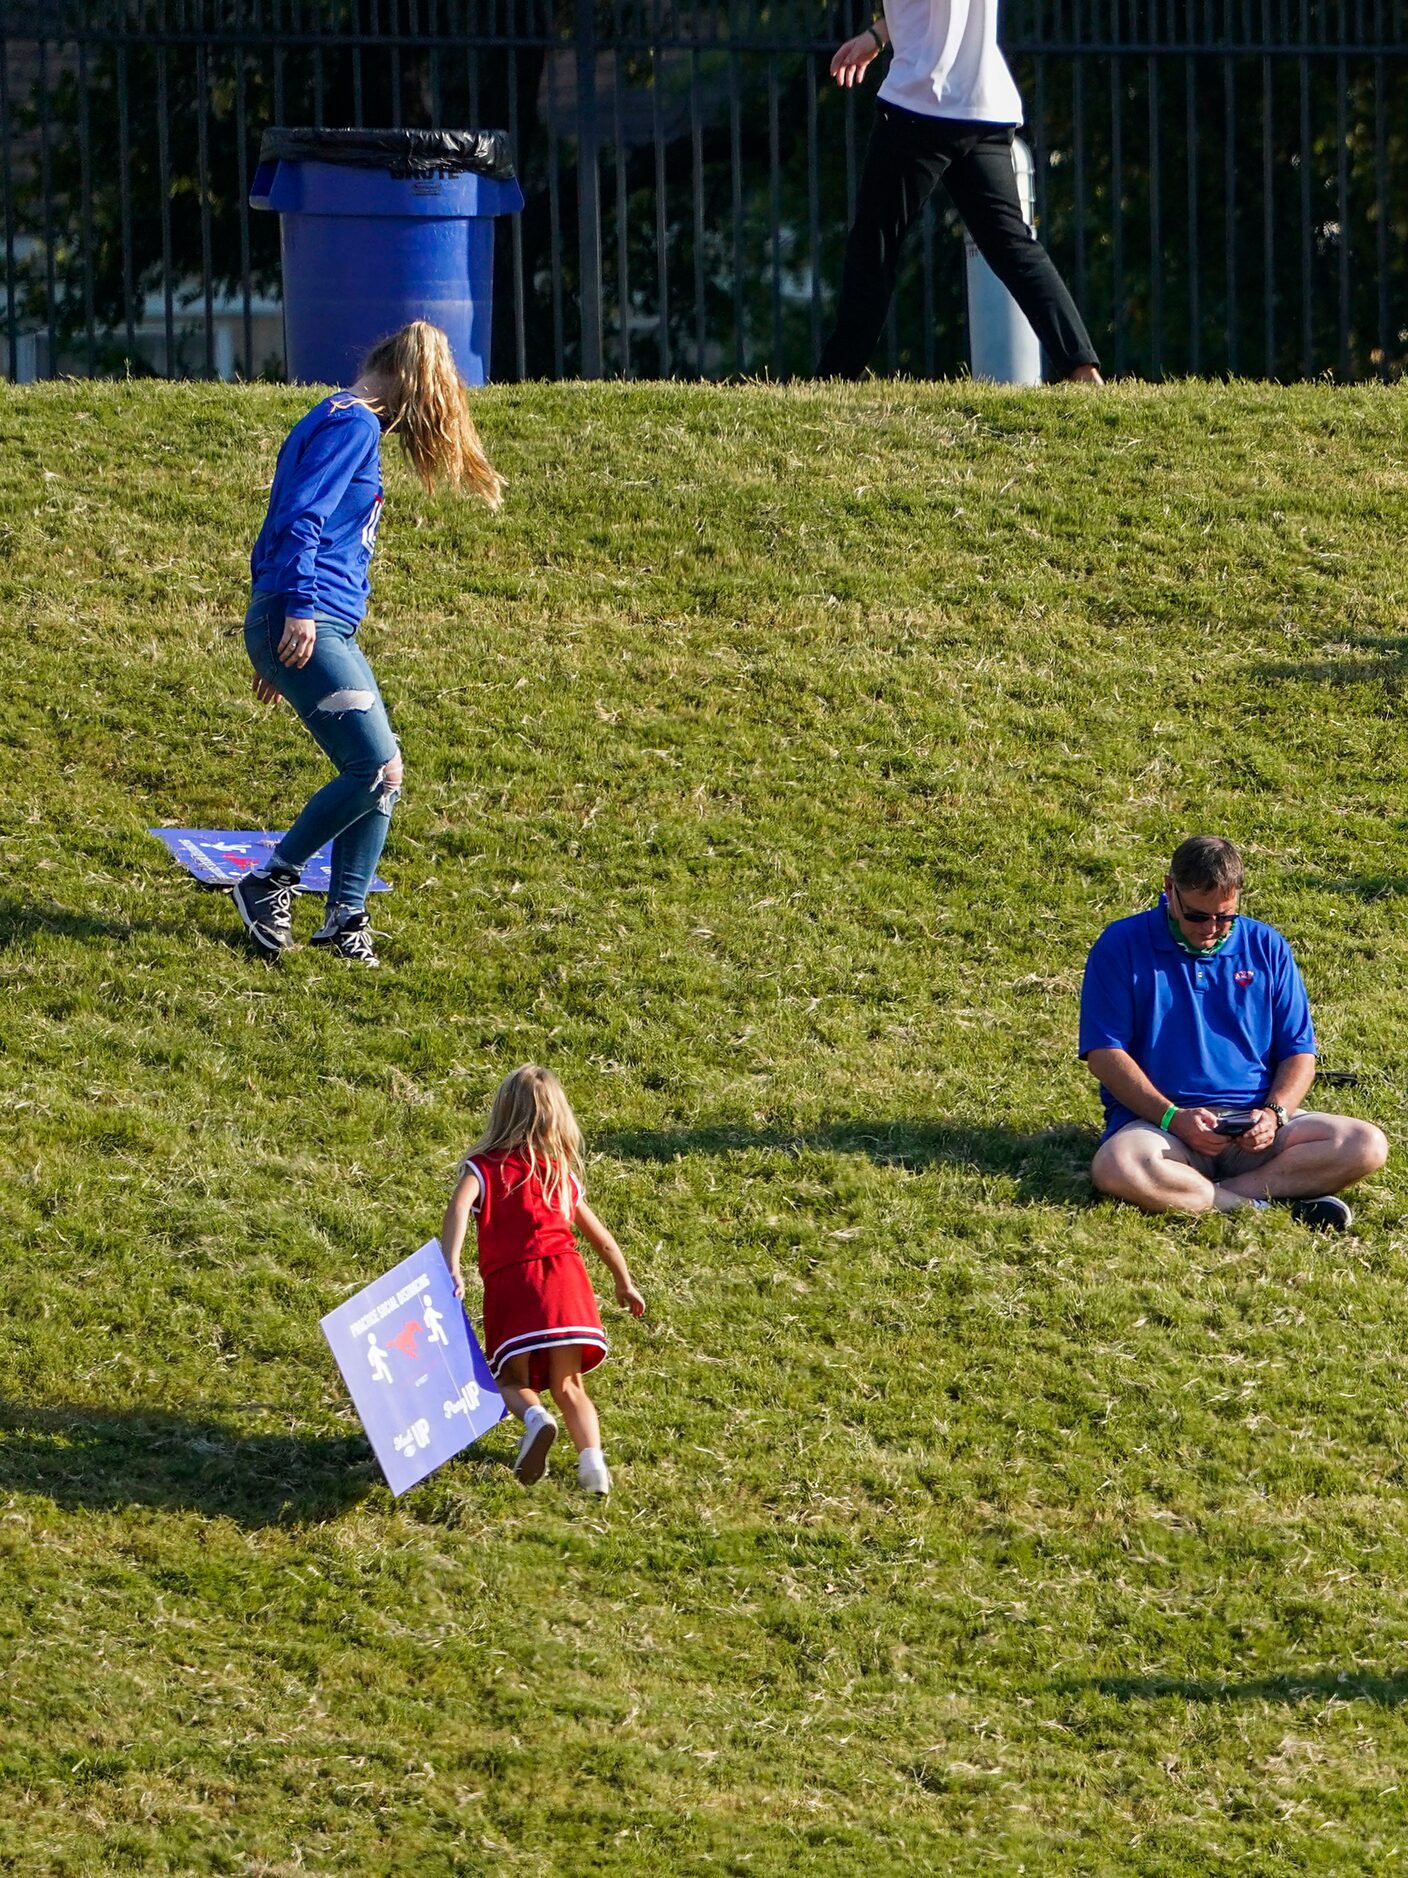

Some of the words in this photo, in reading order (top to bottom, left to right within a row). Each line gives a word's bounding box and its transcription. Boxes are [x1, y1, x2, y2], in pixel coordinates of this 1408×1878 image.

[376, 1295, 401, 1319] SOCIAL
[460, 1379, 481, 1412] UP
[410, 1417, 431, 1450] UP
